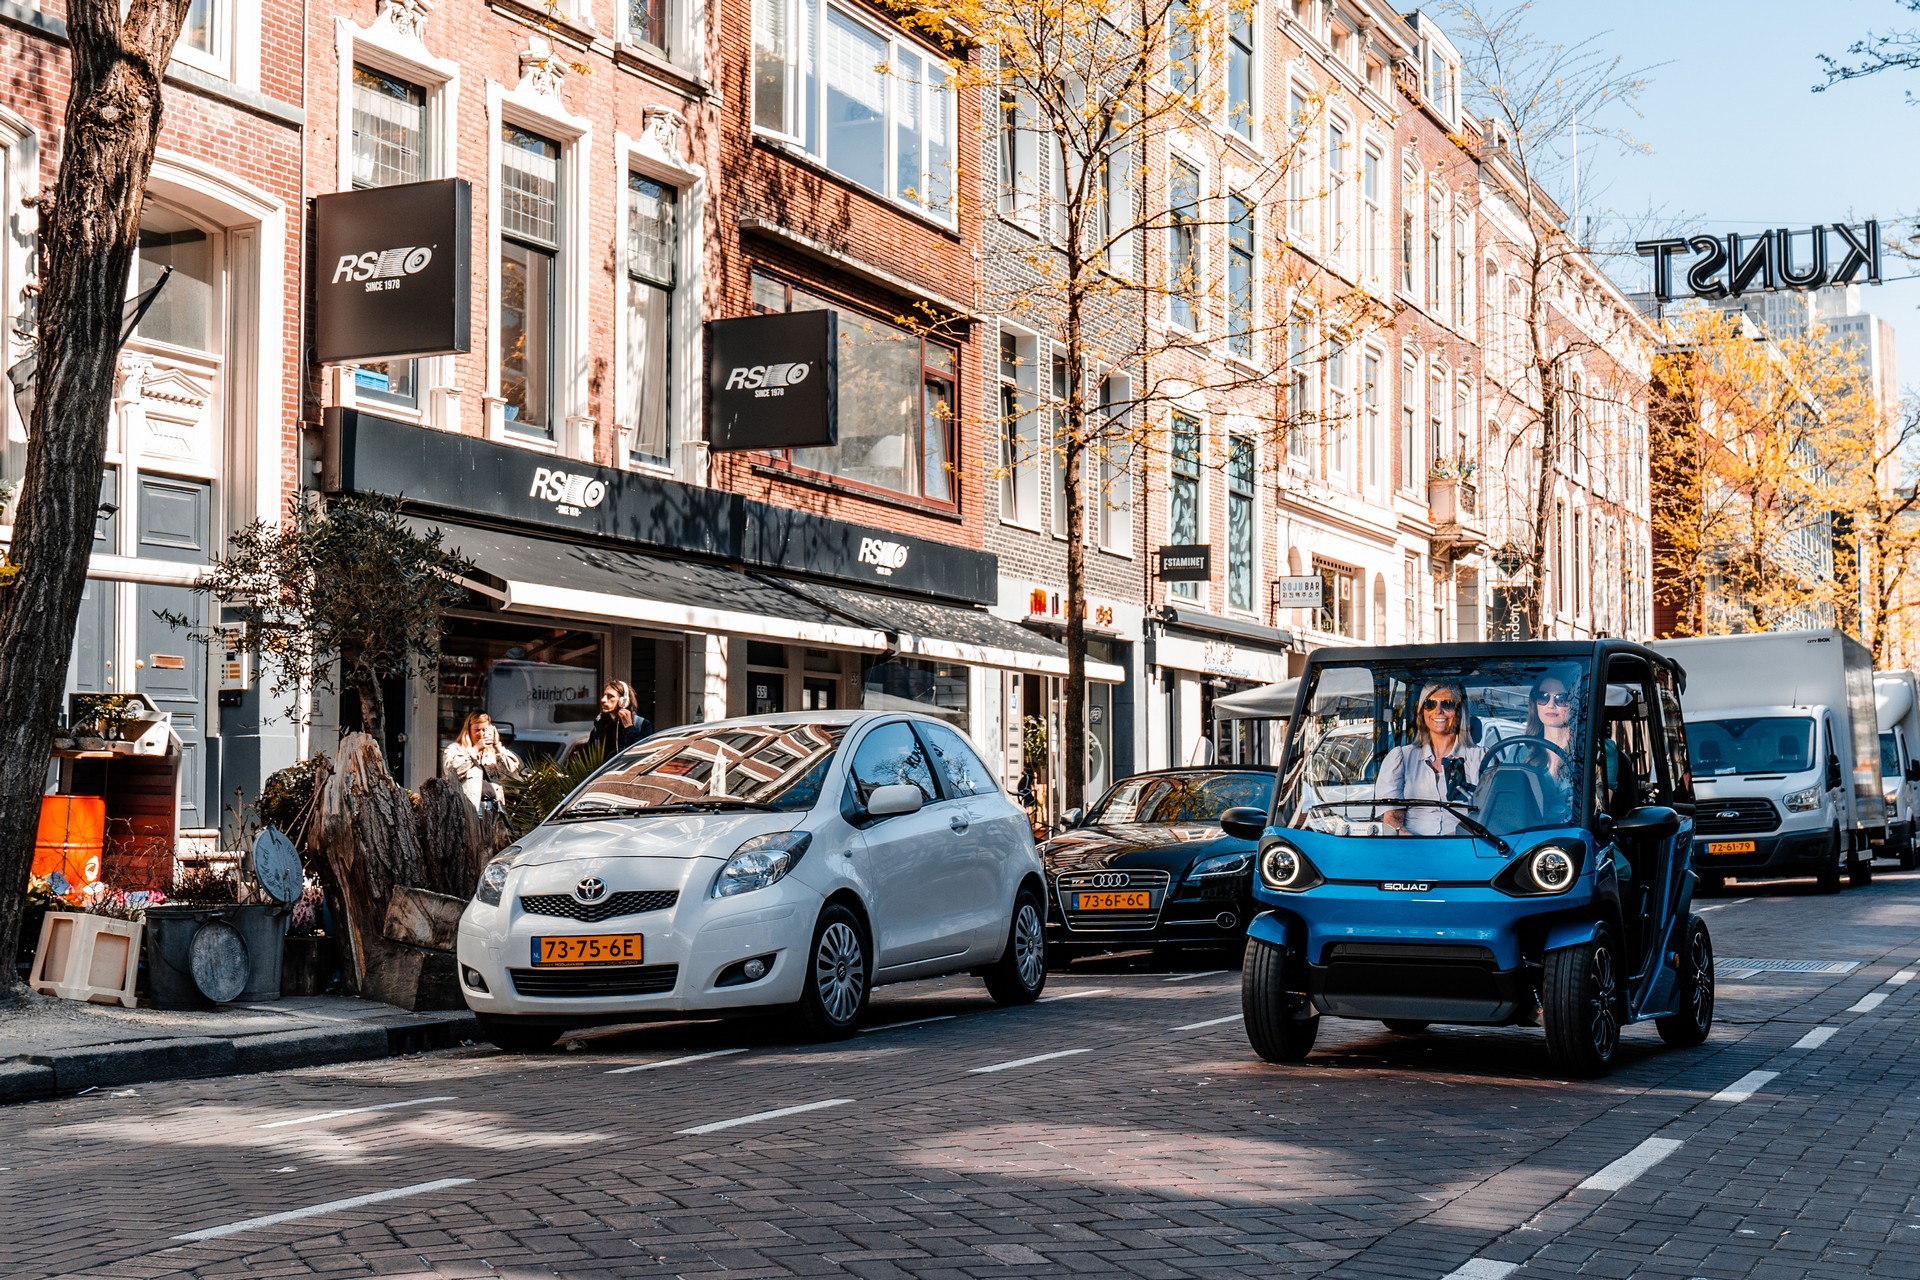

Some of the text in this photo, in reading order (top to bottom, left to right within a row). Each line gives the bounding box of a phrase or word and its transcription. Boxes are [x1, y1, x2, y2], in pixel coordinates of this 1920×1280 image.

[365, 278, 401, 293] SINCE 1978
[754, 387, 785, 398] SINCE 1978
[1163, 556, 1205, 570] ESTAMINET
[1282, 581, 1320, 592] SOJU BAR
[1711, 842, 1751, 852] 72-61-79
[1384, 882, 1428, 891] SQUAD
[1083, 893, 1144, 908] 73-6F-6C
[545, 938, 634, 959] 73-75-6E
